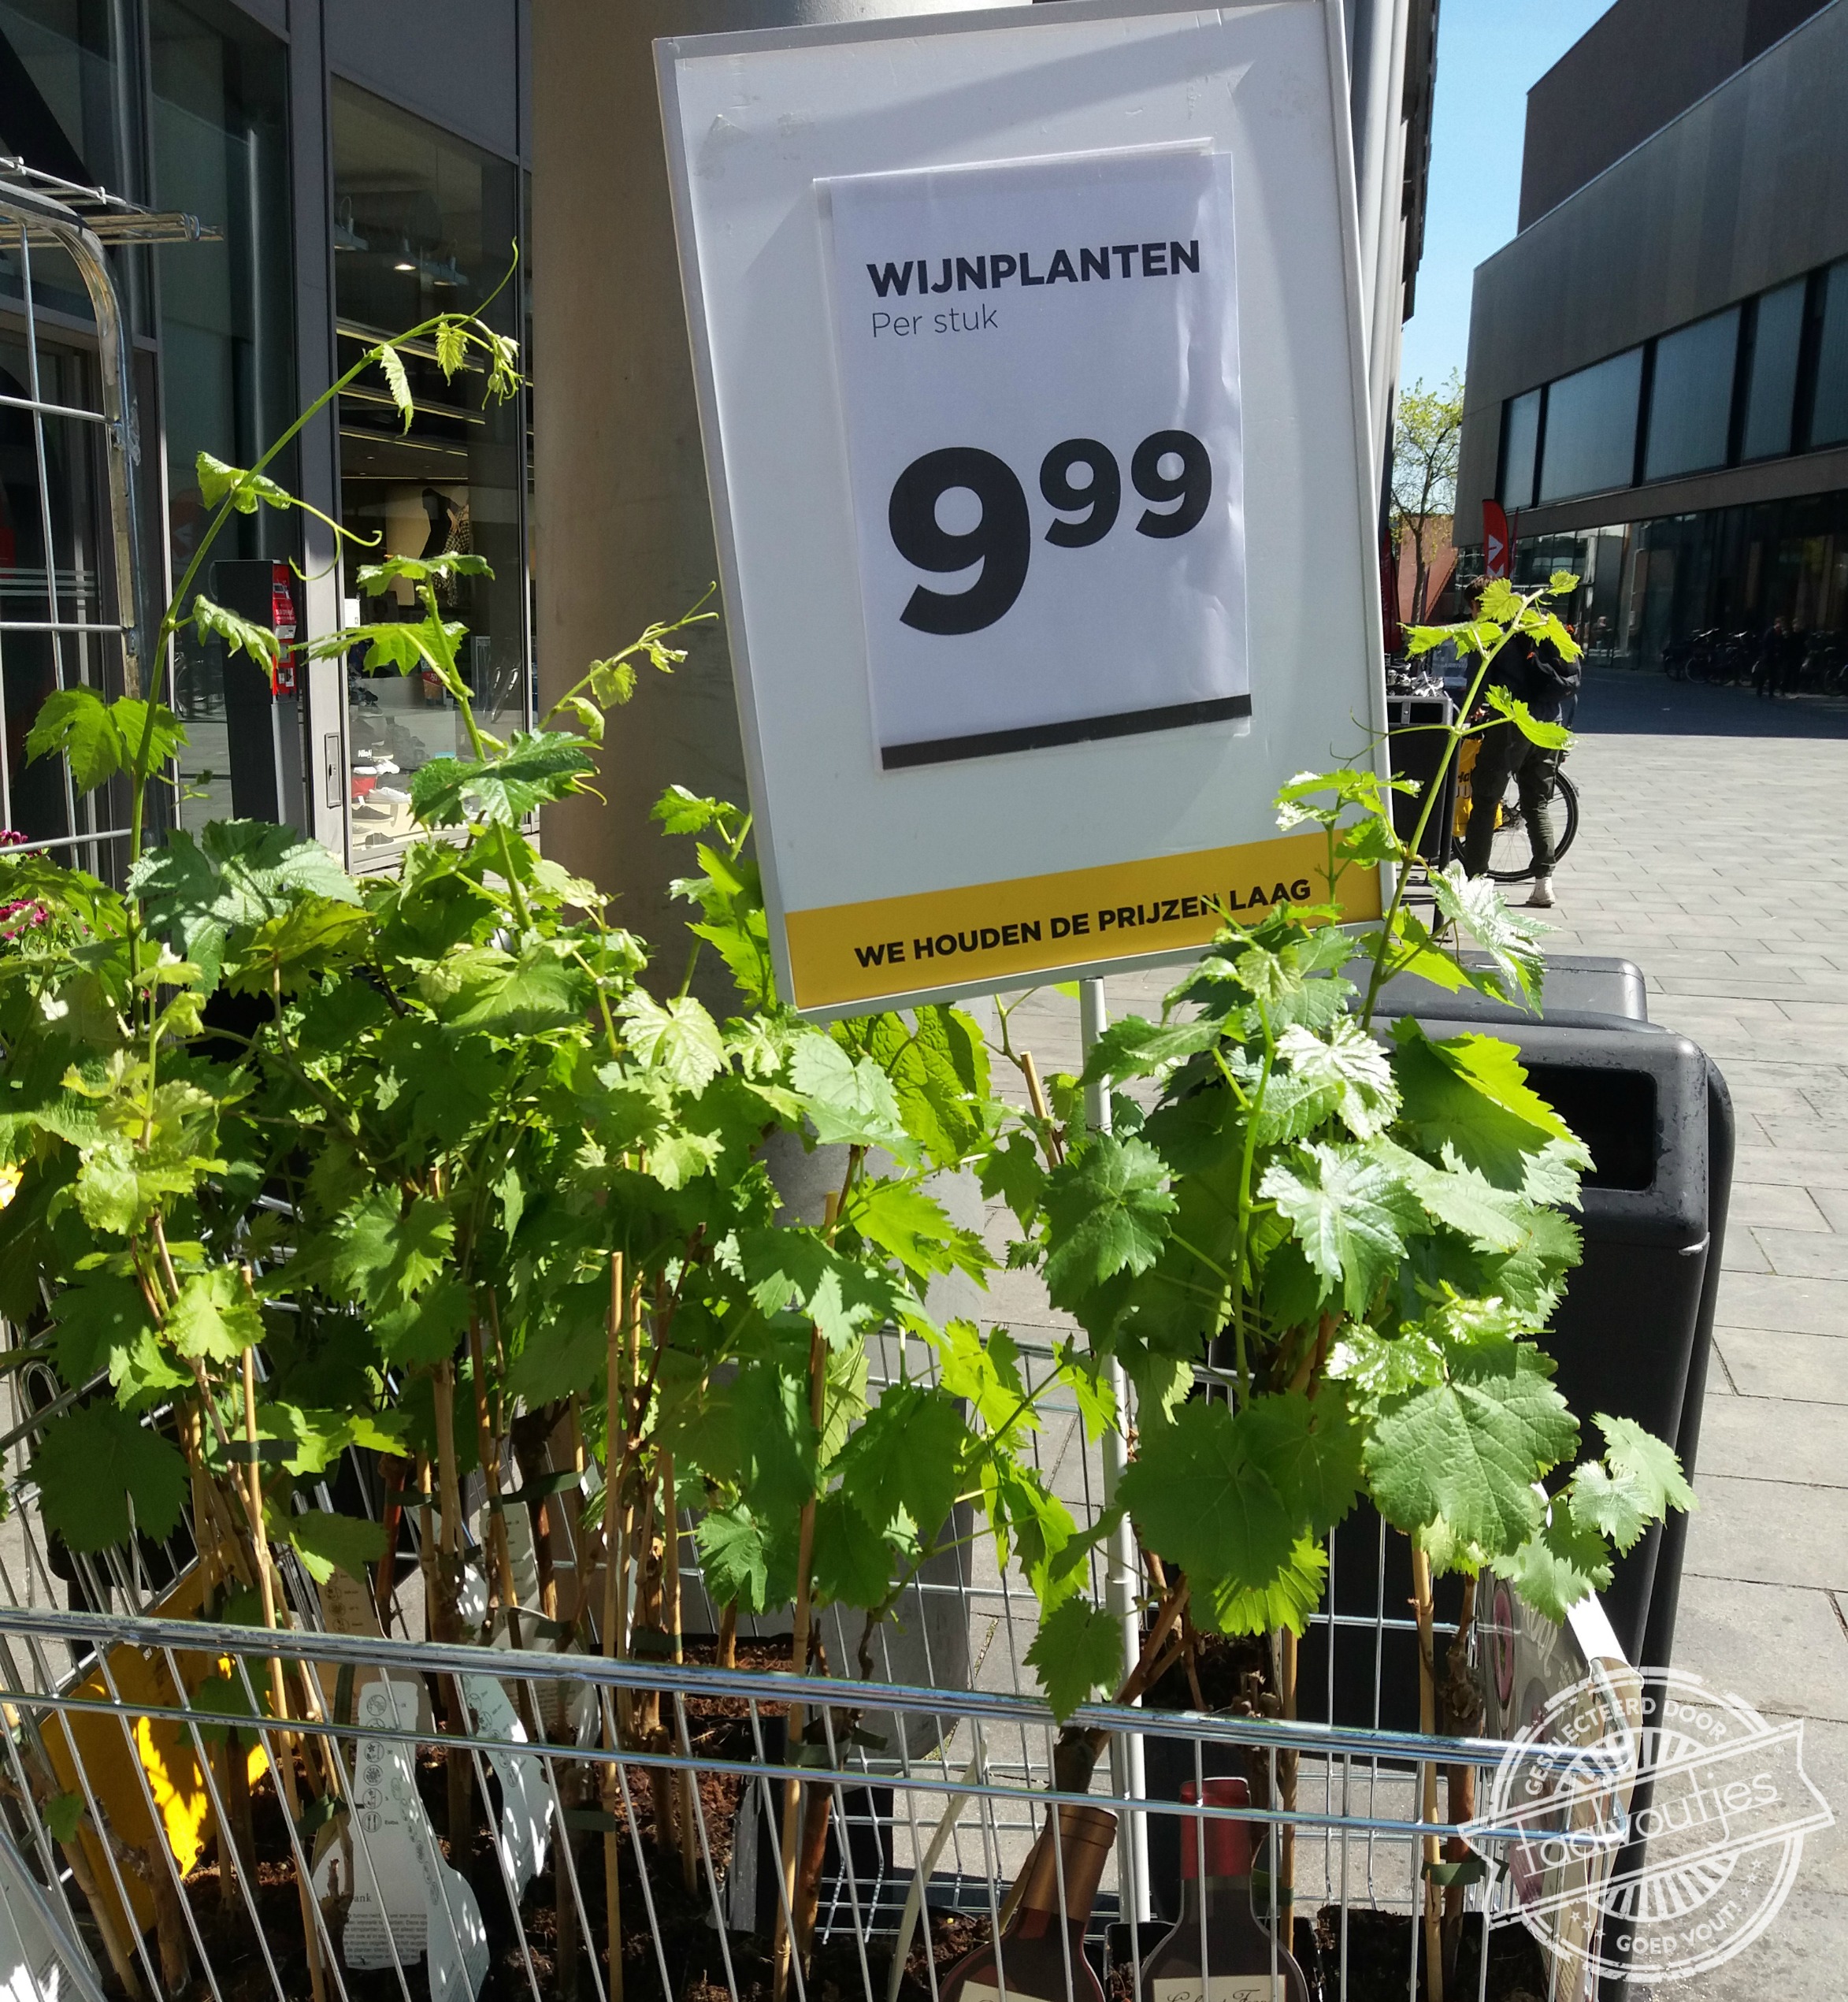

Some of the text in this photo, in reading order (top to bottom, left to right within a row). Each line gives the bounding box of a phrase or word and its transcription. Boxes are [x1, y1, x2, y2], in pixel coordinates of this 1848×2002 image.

[866, 240, 1200, 298] WIJNPLANTEN
[872, 303, 998, 337] Per stuk
[855, 878, 1311, 968] WE HOUDEN DE PRIJZEN LAAG
